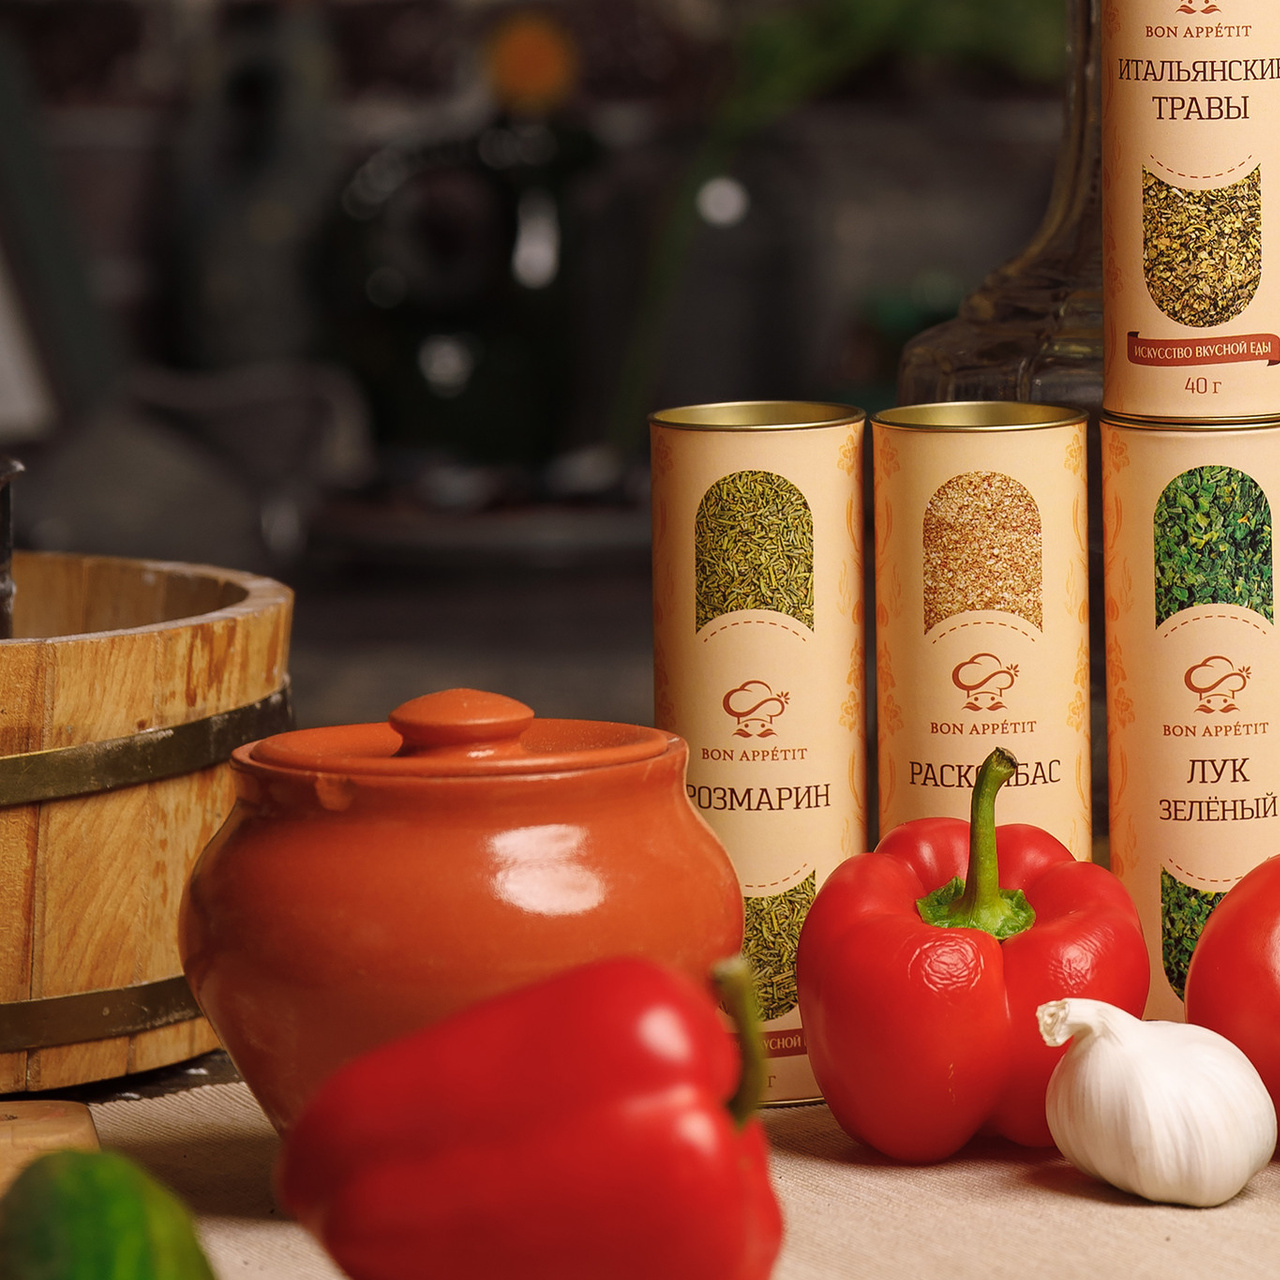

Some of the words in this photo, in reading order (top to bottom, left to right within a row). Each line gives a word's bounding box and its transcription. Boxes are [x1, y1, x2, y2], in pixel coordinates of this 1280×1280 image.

[1146, 26, 1178, 38] BON
[1183, 23, 1252, 38] APPÉTIT
[1152, 96, 1249, 120] ТРАВЫ
[1134, 344, 1193, 359] ИСКУССТВО
[1195, 340, 1247, 358] ВКУСНОЙ
[1250, 341, 1272, 356] ЕДЫ
[1185, 377, 1207, 394] 40
[1213, 382, 1222, 394] г
[931, 722, 964, 734] BON
[969, 719, 1036, 734] APPÉTIT
[1163, 725, 1196, 737] BON
[1202, 721, 1269, 737] APPÉTIT
[702, 748, 734, 761] BON
[739, 746, 807, 761] APPÉTIT
[909, 759, 1061, 788] РАСКБАС
[1187, 758, 1250, 783] ЛУК
[1160, 792, 1278, 821] ЗЕЛЁНЫЙ
